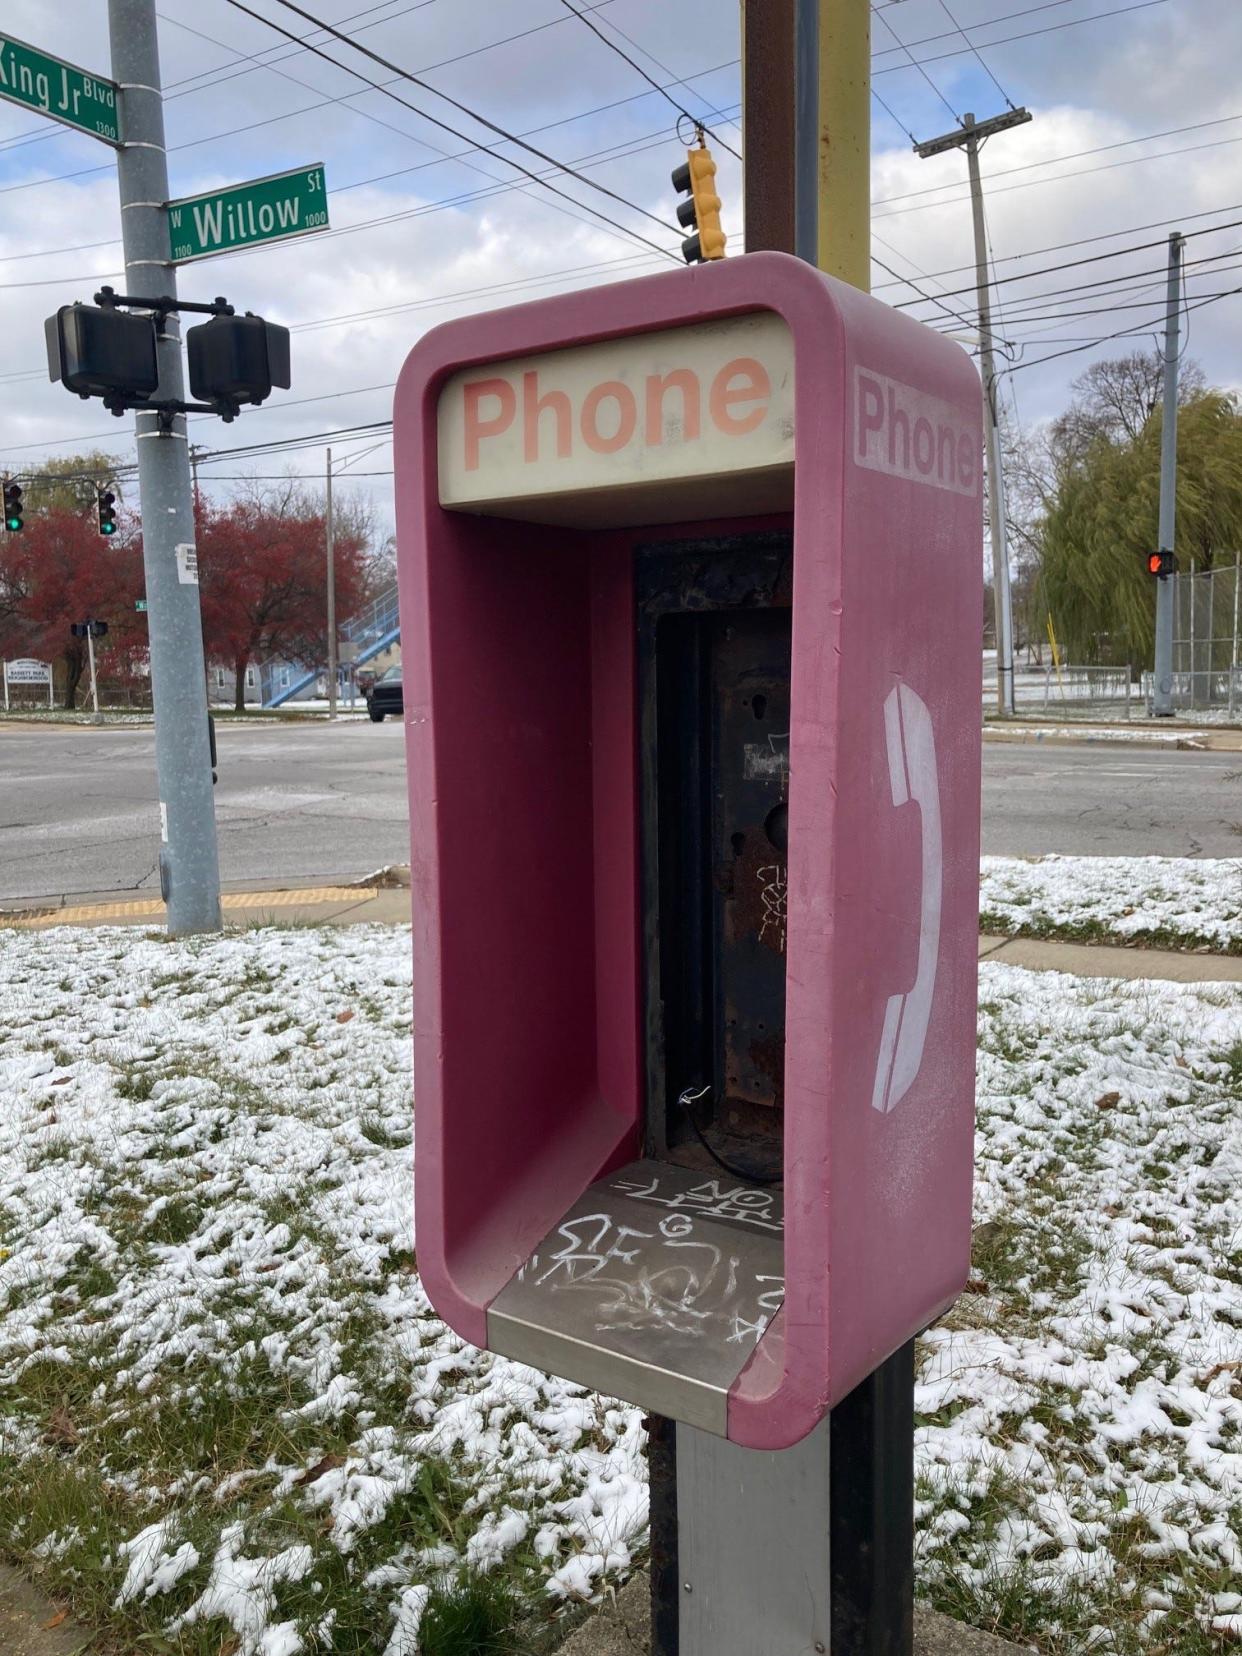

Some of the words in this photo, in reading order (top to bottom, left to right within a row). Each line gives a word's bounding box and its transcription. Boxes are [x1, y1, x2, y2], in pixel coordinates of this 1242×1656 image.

[58, 67, 81, 115] Jr
[83, 77, 114, 108] Blvd
[96, 120, 116, 138] 1300
[171, 209, 182, 228] W
[192, 197, 299, 248] Willow
[307, 172, 321, 193] St
[305, 211, 326, 227] 1000
[174, 243, 192, 259] 1100
[462, 357, 772, 472] Phone
[858, 373, 977, 488] Phone
